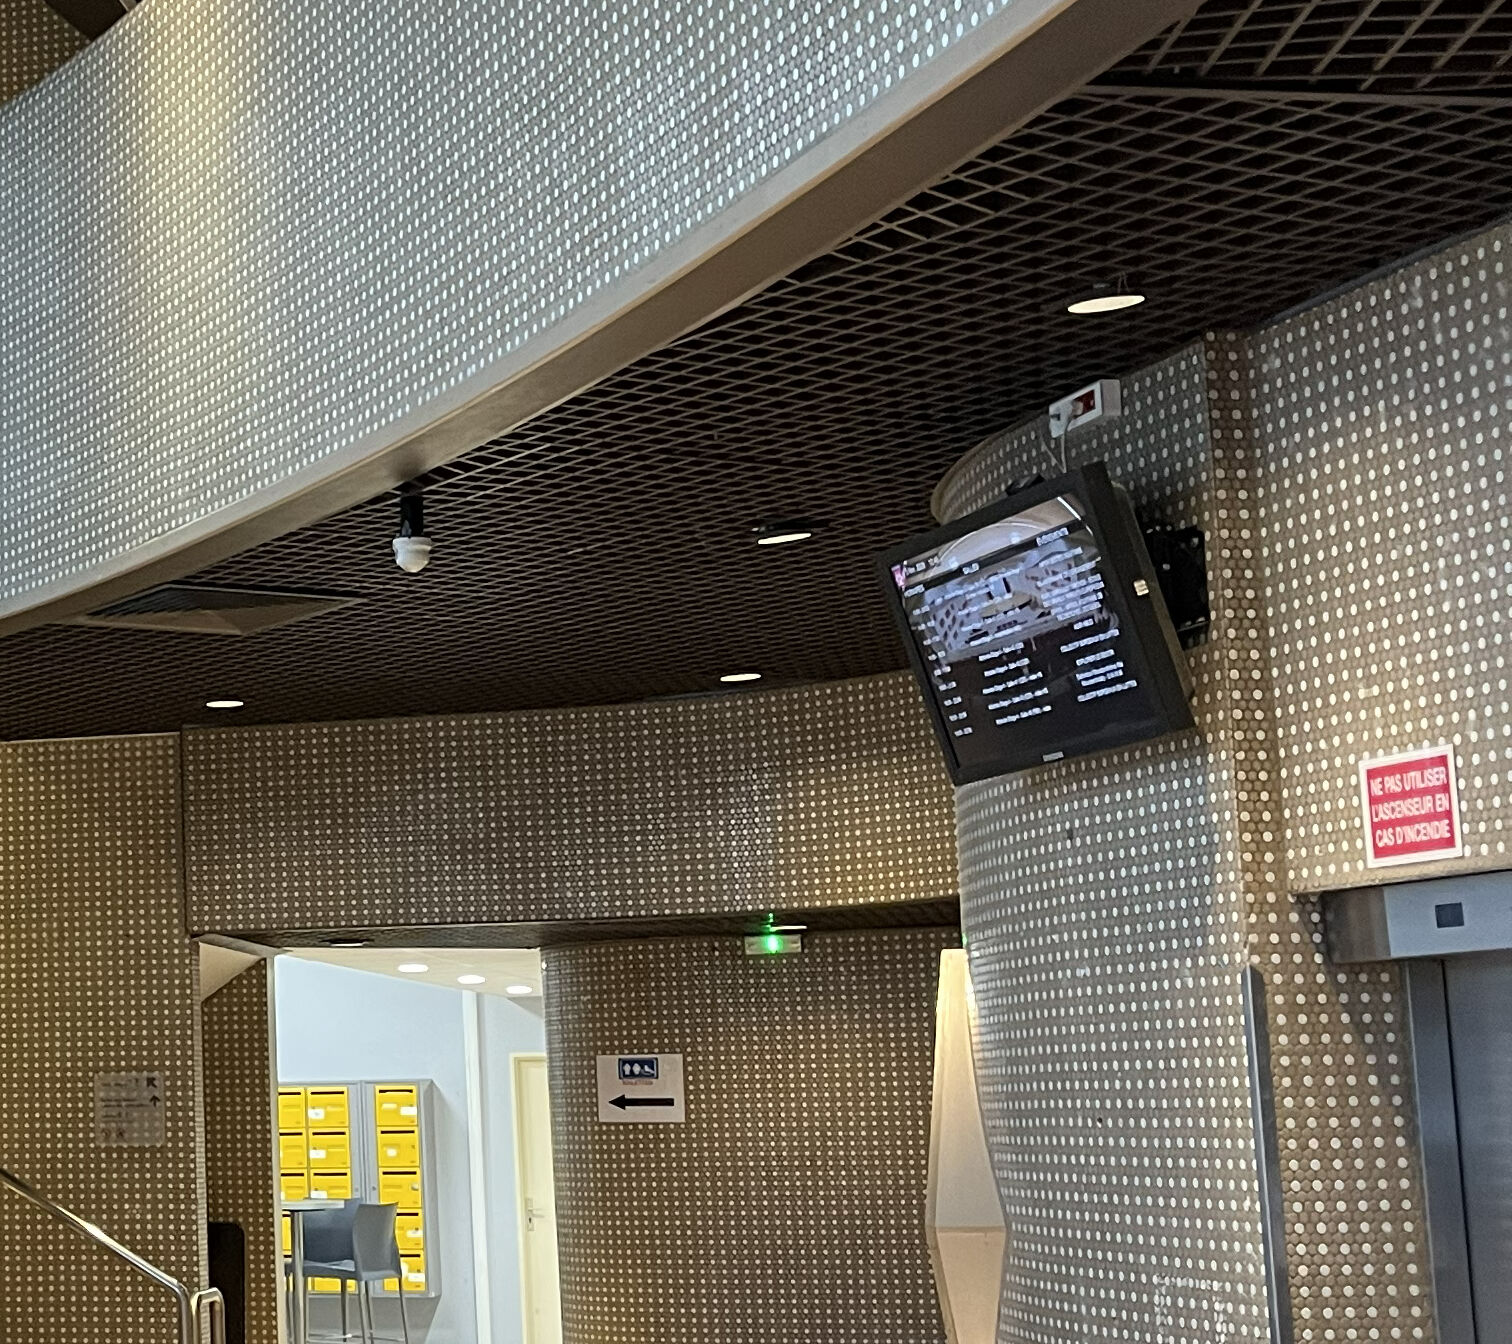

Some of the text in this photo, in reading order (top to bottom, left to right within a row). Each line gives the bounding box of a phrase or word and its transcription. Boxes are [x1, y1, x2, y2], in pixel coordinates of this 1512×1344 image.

[1370, 766, 1448, 796] NE PAS UTILISER
[1435, 792, 1450, 812] EN
[1375, 819, 1451, 848] CAS D'INCENDIE
